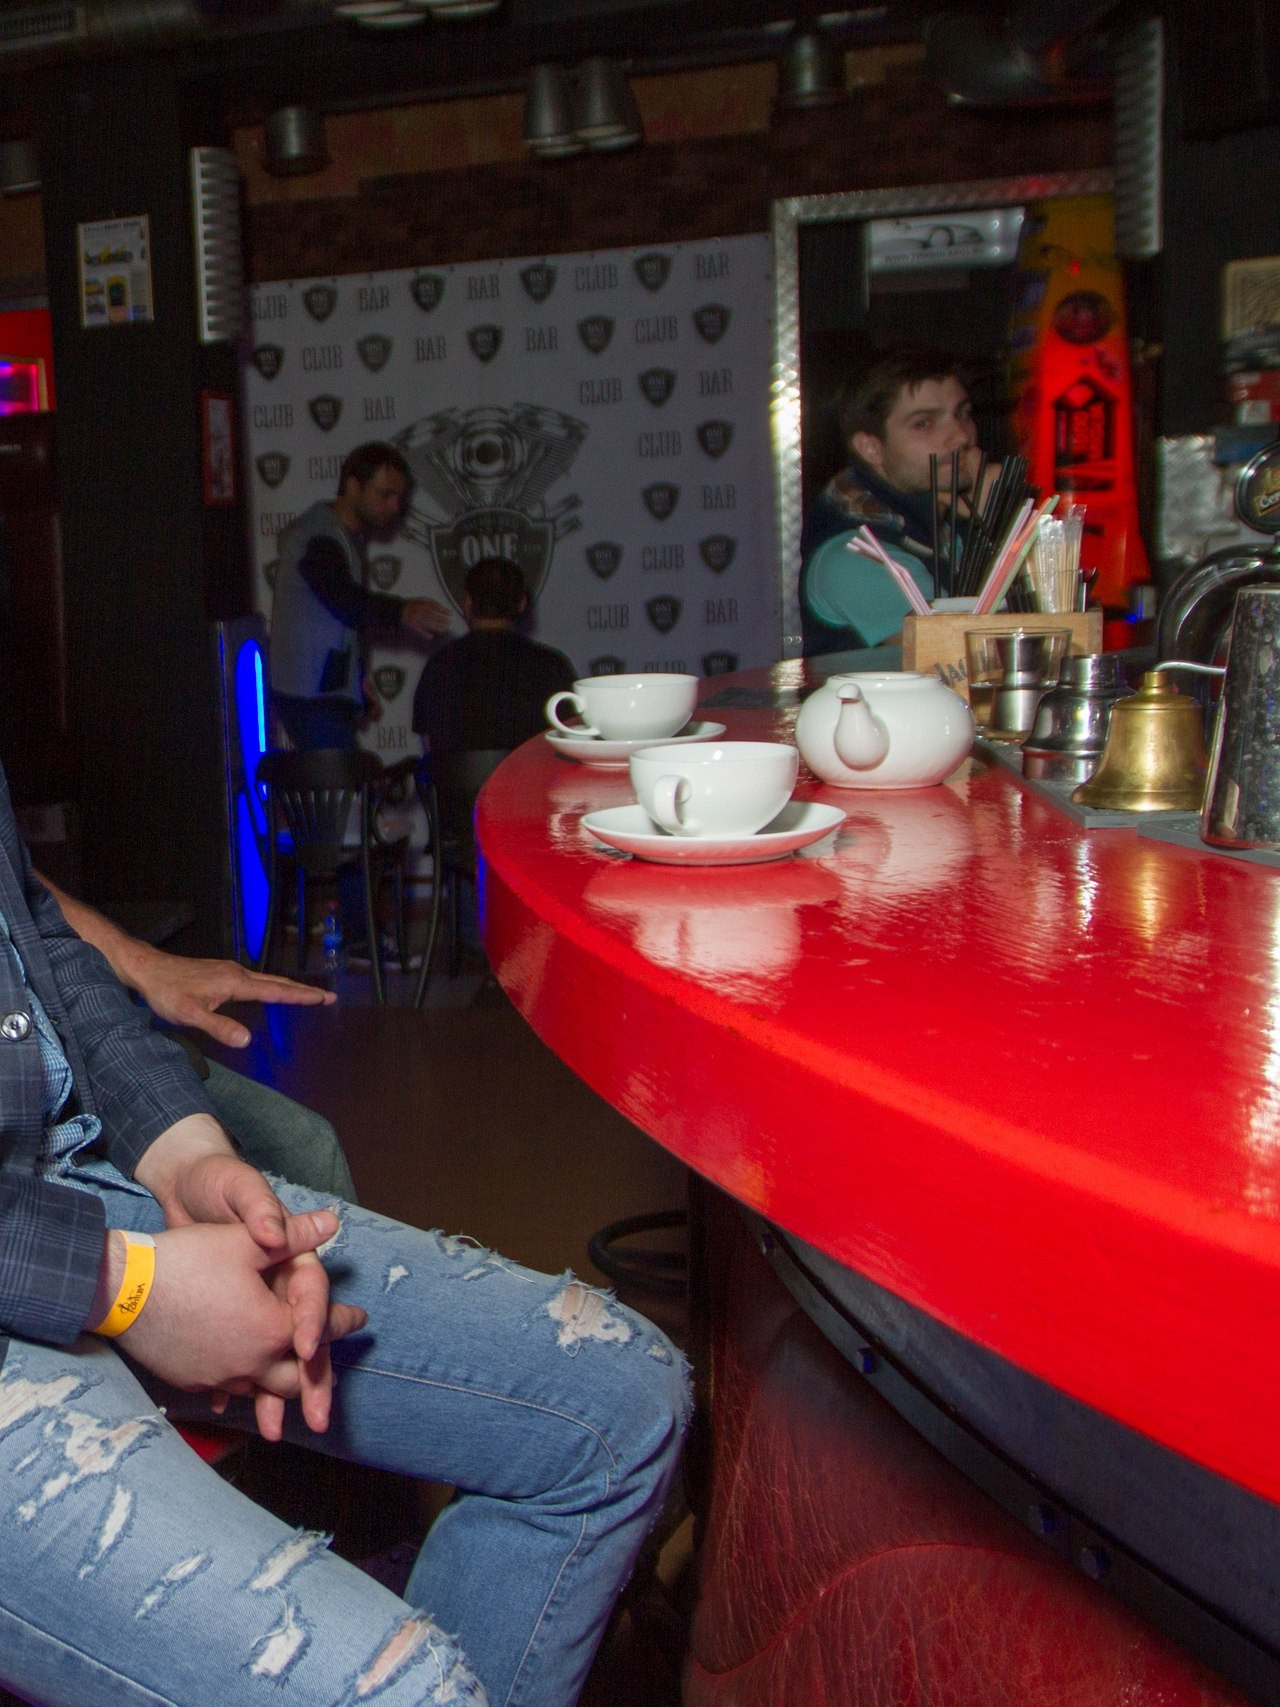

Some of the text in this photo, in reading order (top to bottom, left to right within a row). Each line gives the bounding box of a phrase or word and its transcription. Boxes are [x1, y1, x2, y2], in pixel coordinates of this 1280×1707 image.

[358, 285, 390, 311] BAR
[467, 273, 500, 300] BAR
[575, 263, 618, 291] CLUB
[695, 252, 730, 279] BAR
[302, 344, 343, 371] CLUB
[415, 336, 447, 363] BAR
[525, 325, 558, 352] BAR
[634, 315, 678, 343] CLUB
[578, 377, 623, 405] CLUB
[700, 368, 733, 395] BAR
[253, 403, 294, 429] CLUB
[363, 395, 396, 421] BAR
[639, 430, 682, 458] CLUB
[702, 484, 737, 510] BAR
[462, 534, 519, 567] ONE
[642, 544, 685, 571] CLUB
[587, 604, 630, 630] CLUB
[706, 597, 739, 624] BAR
[376, 725, 409, 750] BAR
